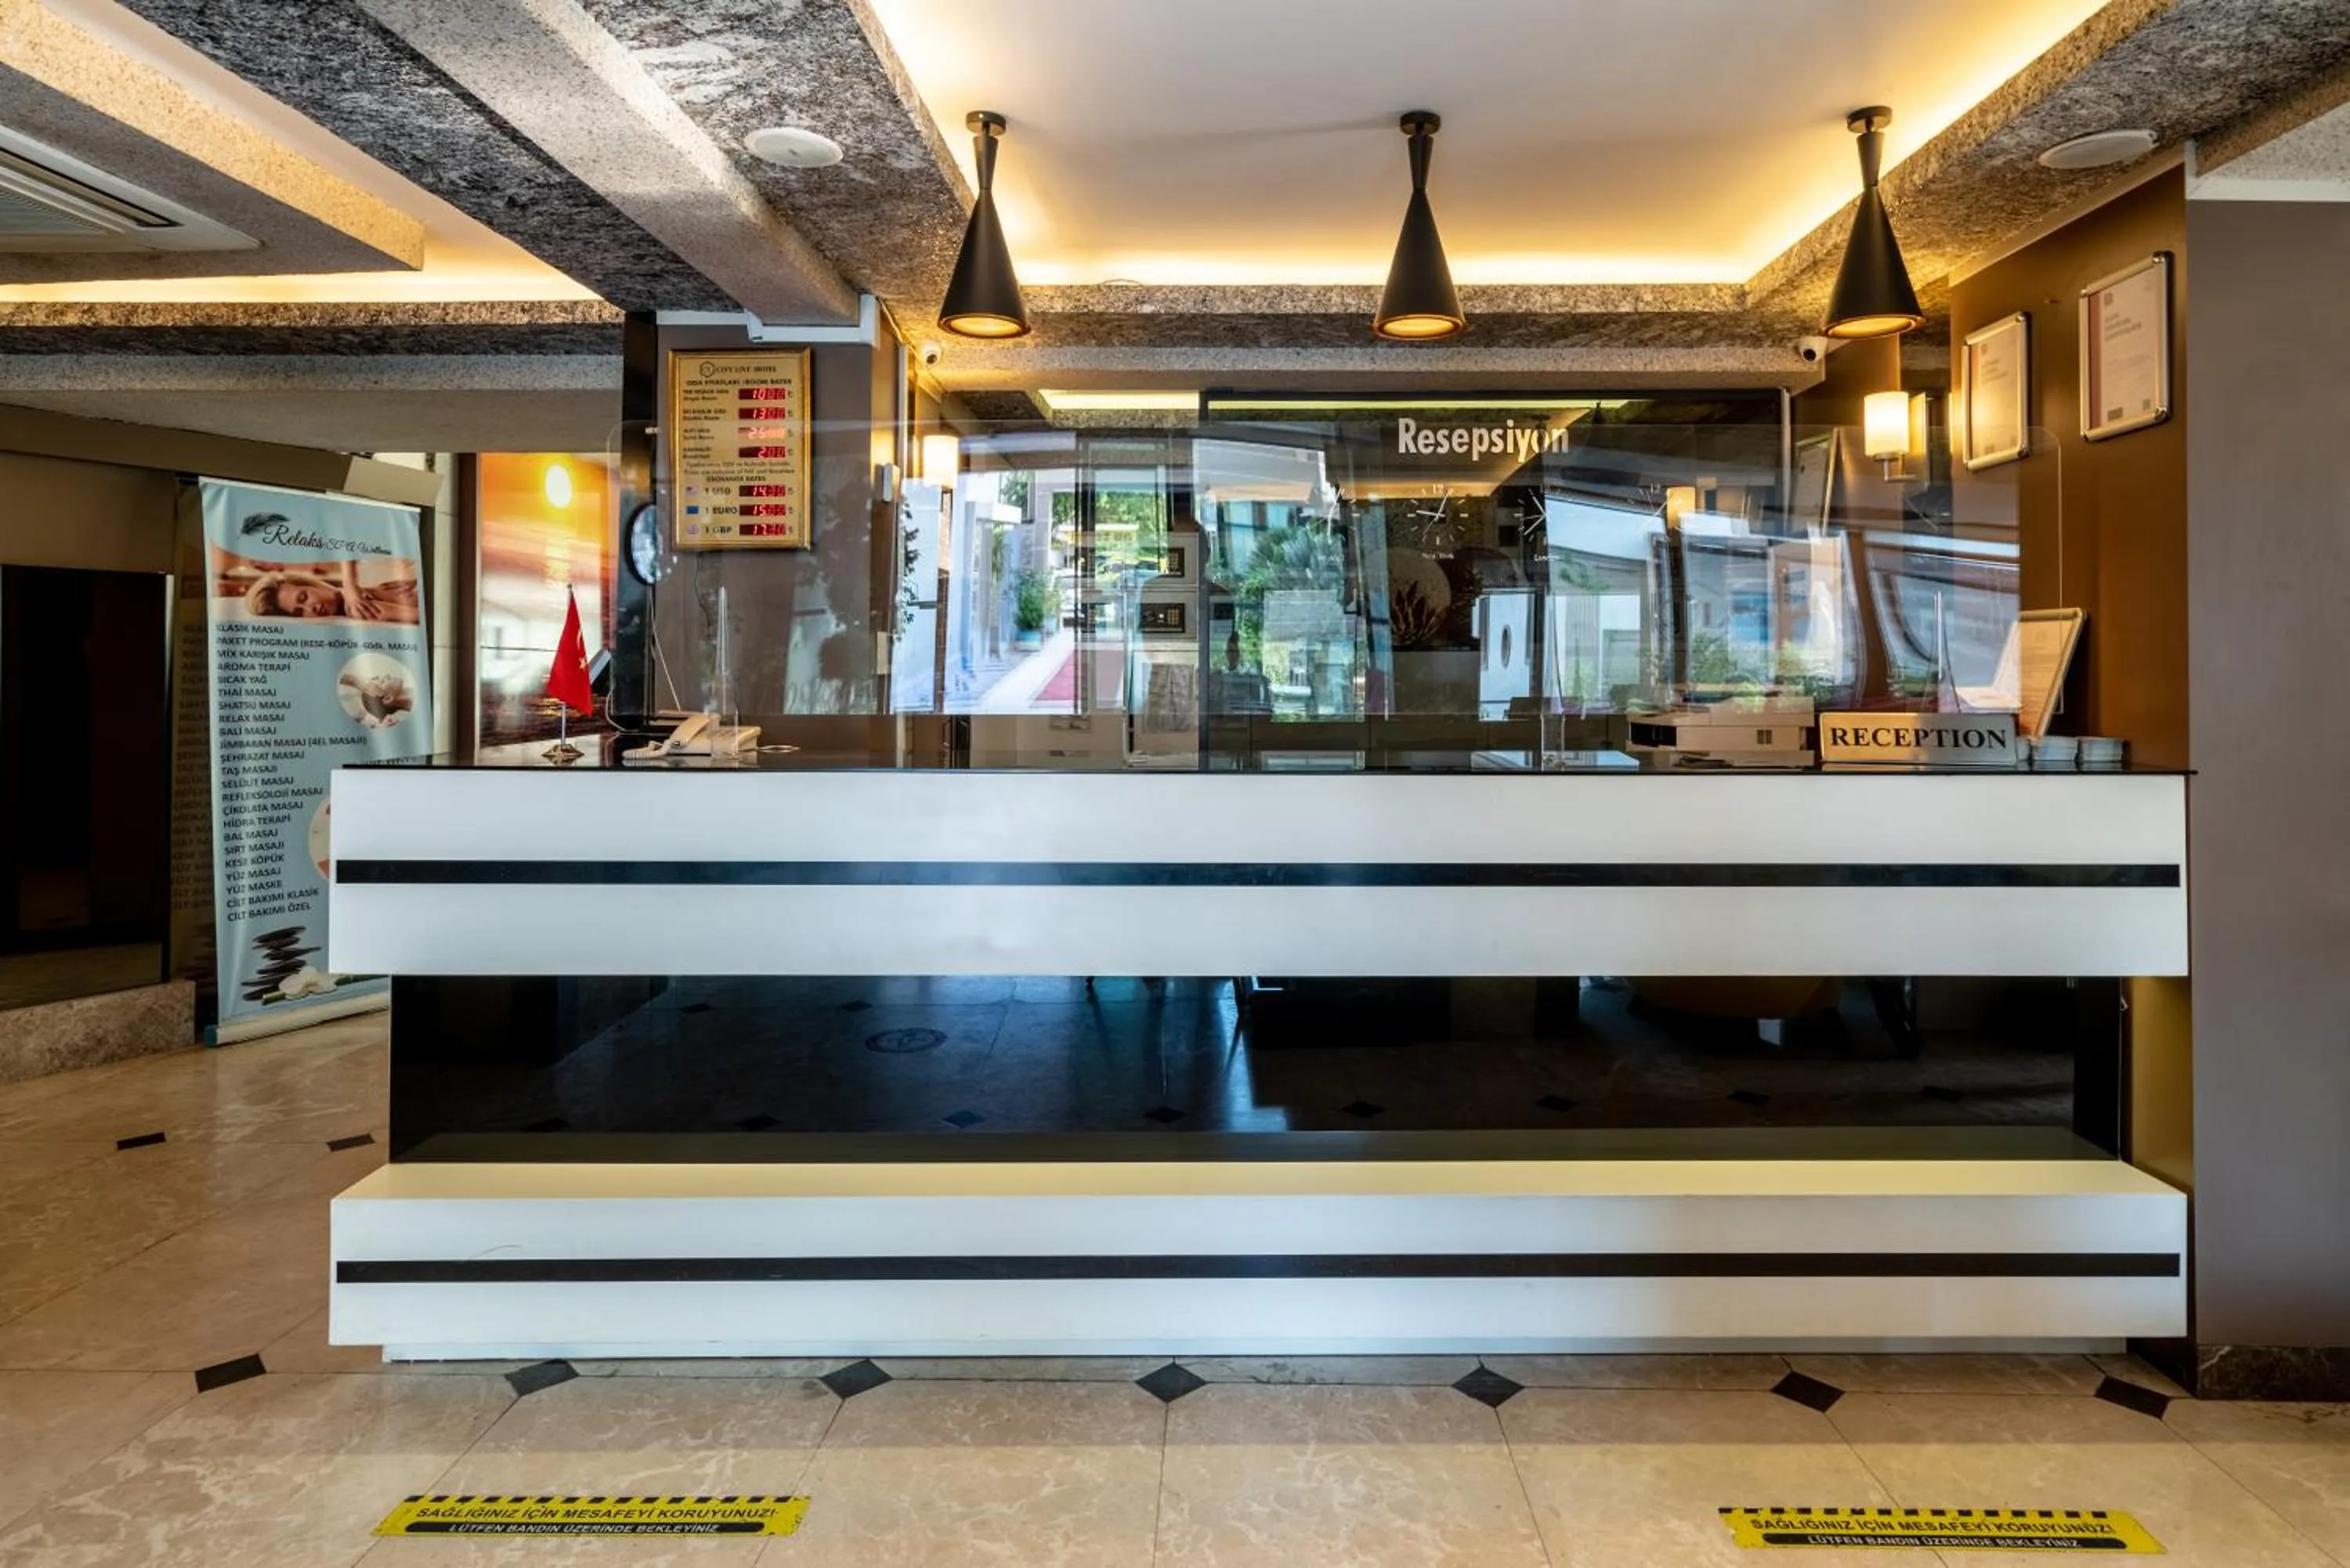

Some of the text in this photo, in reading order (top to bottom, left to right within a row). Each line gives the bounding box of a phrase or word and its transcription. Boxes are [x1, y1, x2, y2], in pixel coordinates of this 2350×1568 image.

[1398, 418, 1568, 463] Resepsiyon
[262, 524, 323, 549] Relaks
[249, 638, 298, 647] PROGRAM
[217, 663, 255, 671] AROMA
[219, 714, 251, 723] RELAX
[1830, 726, 2007, 749] RECEPTION
[221, 767, 240, 776] TAŞ
[224, 833, 243, 842] BAL
[248, 880, 282, 891] MASKE
[287, 901, 312, 912] ÖZEL
[416, 1506, 517, 1519] SAĞLIĞINIZ
[522, 1505, 559, 1519] İÇİN
[562, 1507, 656, 1519] MESAFEYİ
[448, 1523, 721, 1534] LÜTFEN BANDIN ÜZERİNDE BEKLEYİNİZ
[1751, 1518, 1856, 1530] SAĞLIĞINIZ
[1861, 1518, 1894, 1531] İÇİN
[1898, 1520, 1991, 1532] MESAFEYİ
[1807, 1534, 1863, 1545] LÜTFEN
[1868, 1536, 1920, 1545] BANDIN
[1923, 1536, 1996, 1547] ÜZERİNDE
